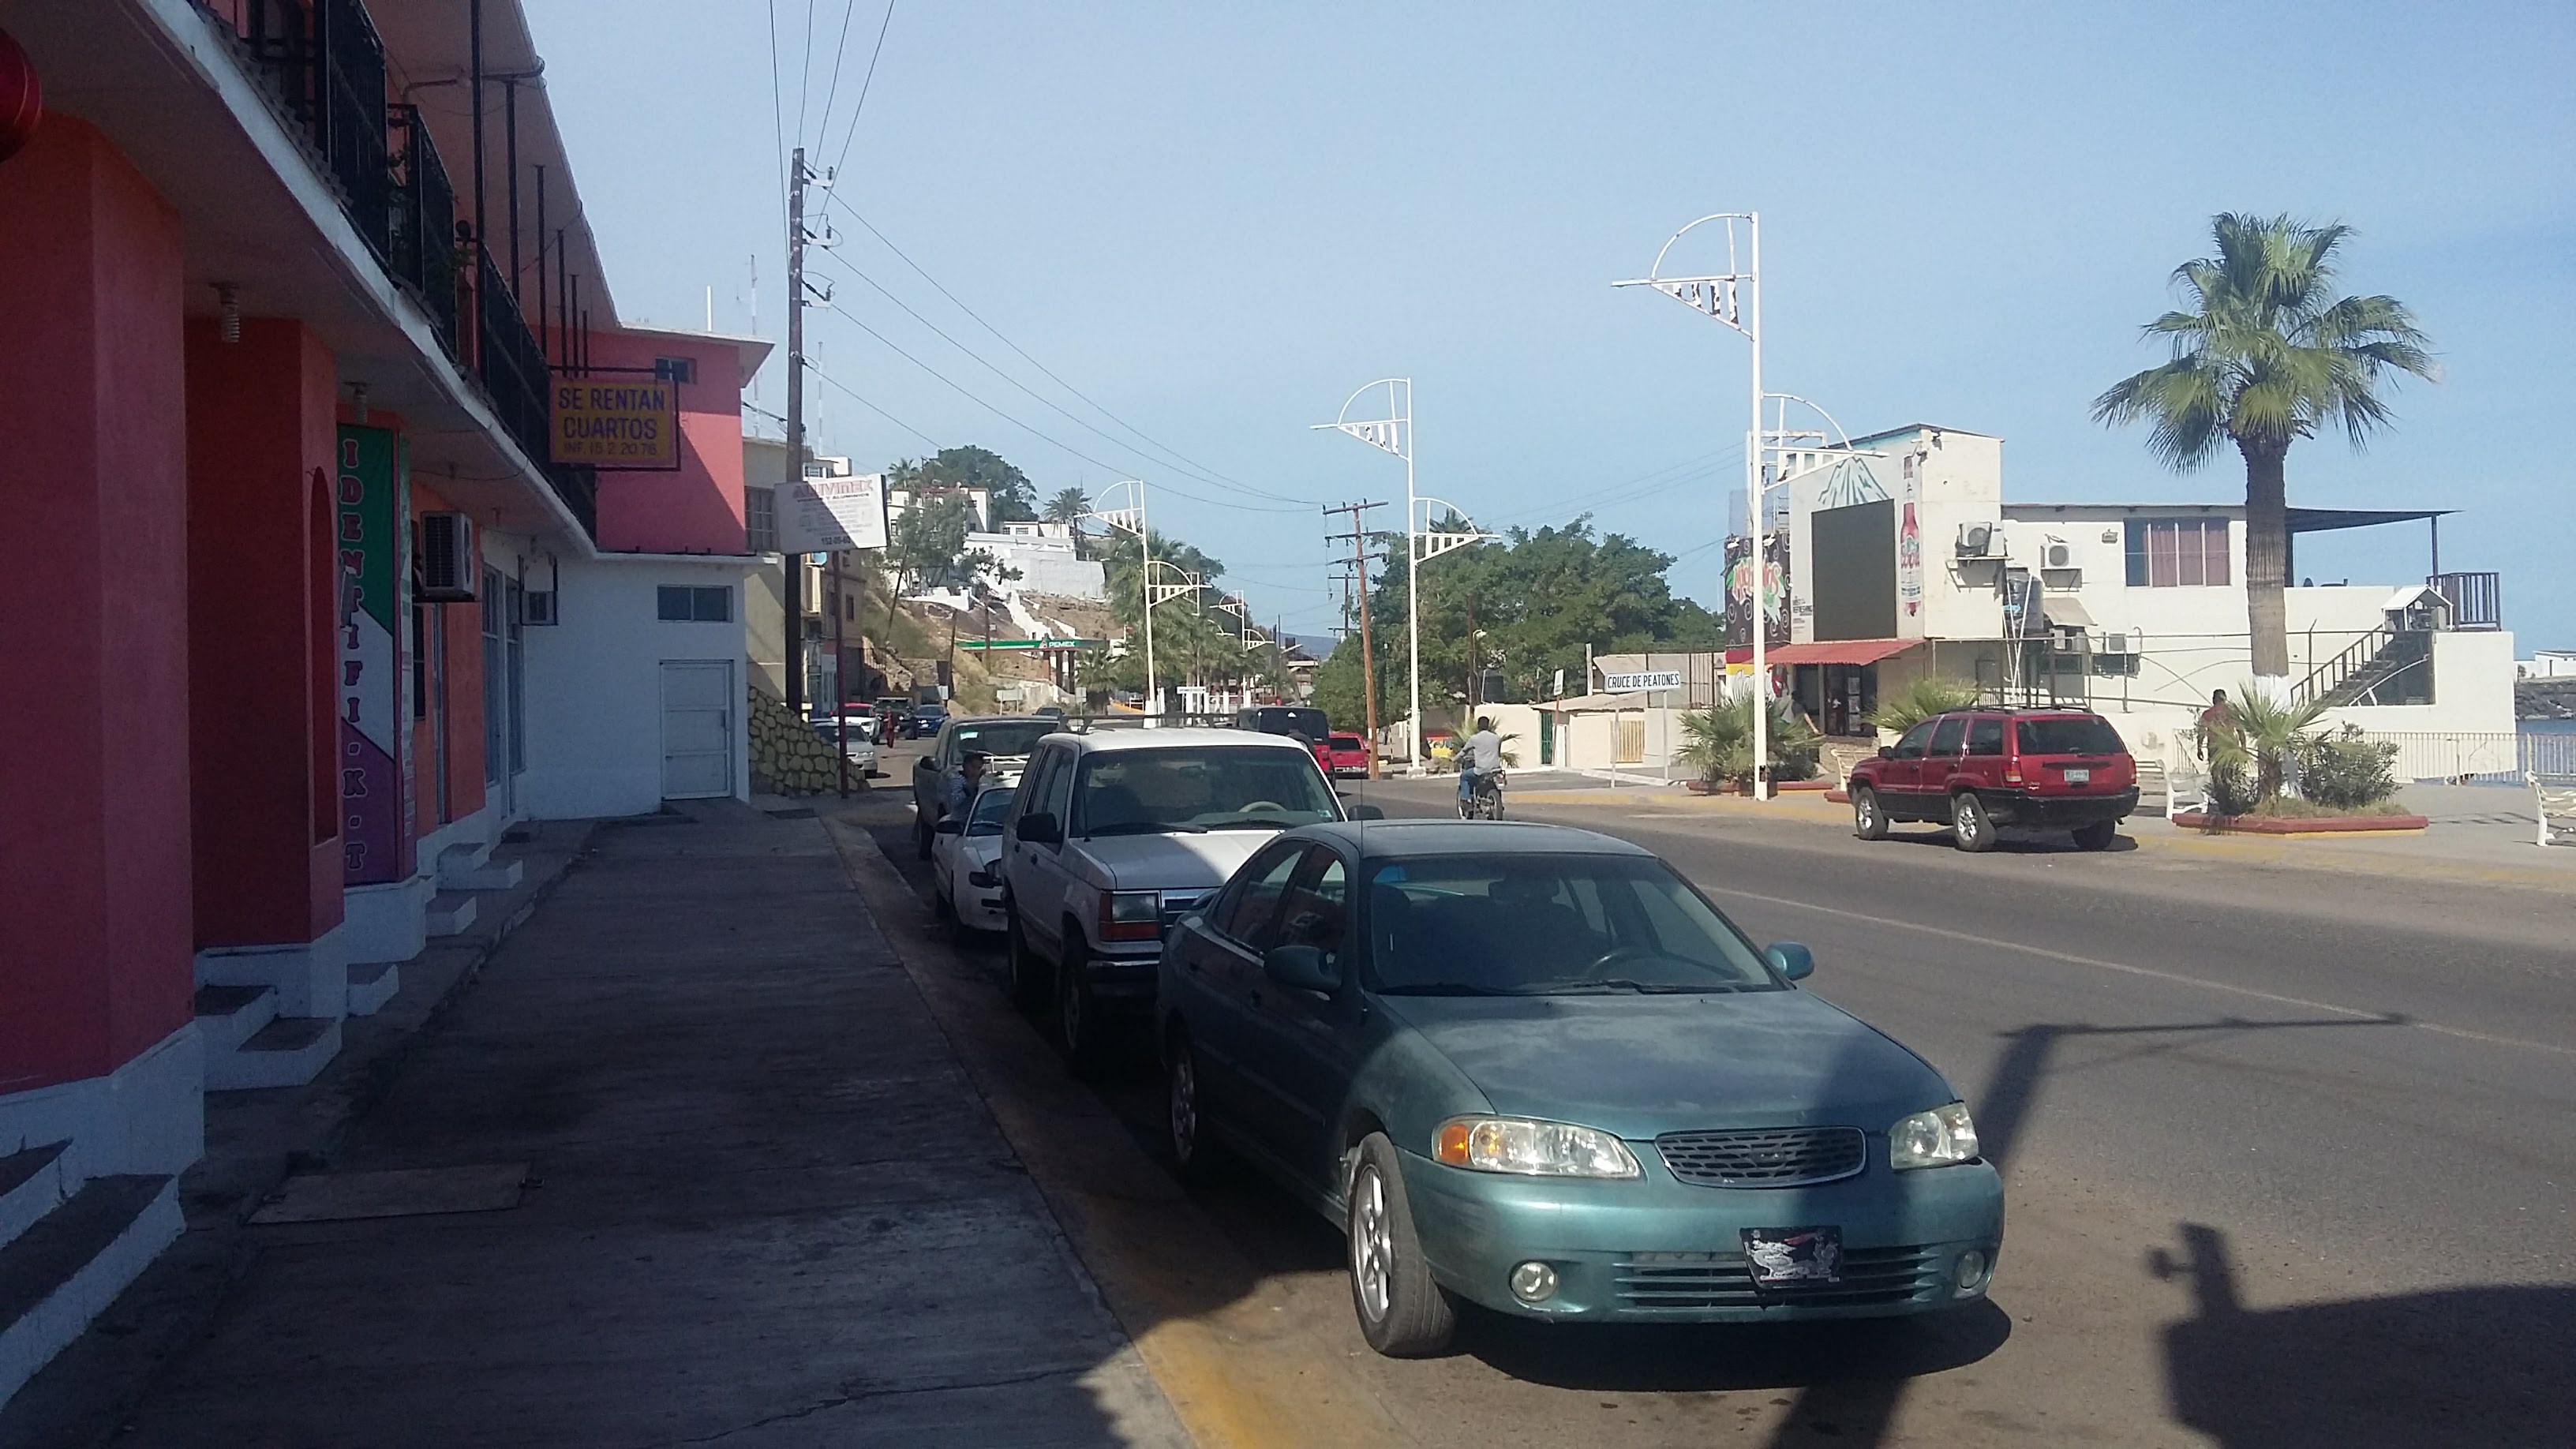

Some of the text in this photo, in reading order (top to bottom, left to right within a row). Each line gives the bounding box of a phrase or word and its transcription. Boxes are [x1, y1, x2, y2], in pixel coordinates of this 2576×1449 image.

[559, 387, 665, 410] SE RENTAN
[564, 417, 657, 440] CUARTOS
[1608, 673, 1679, 688] CRUCE DE PEATONES
